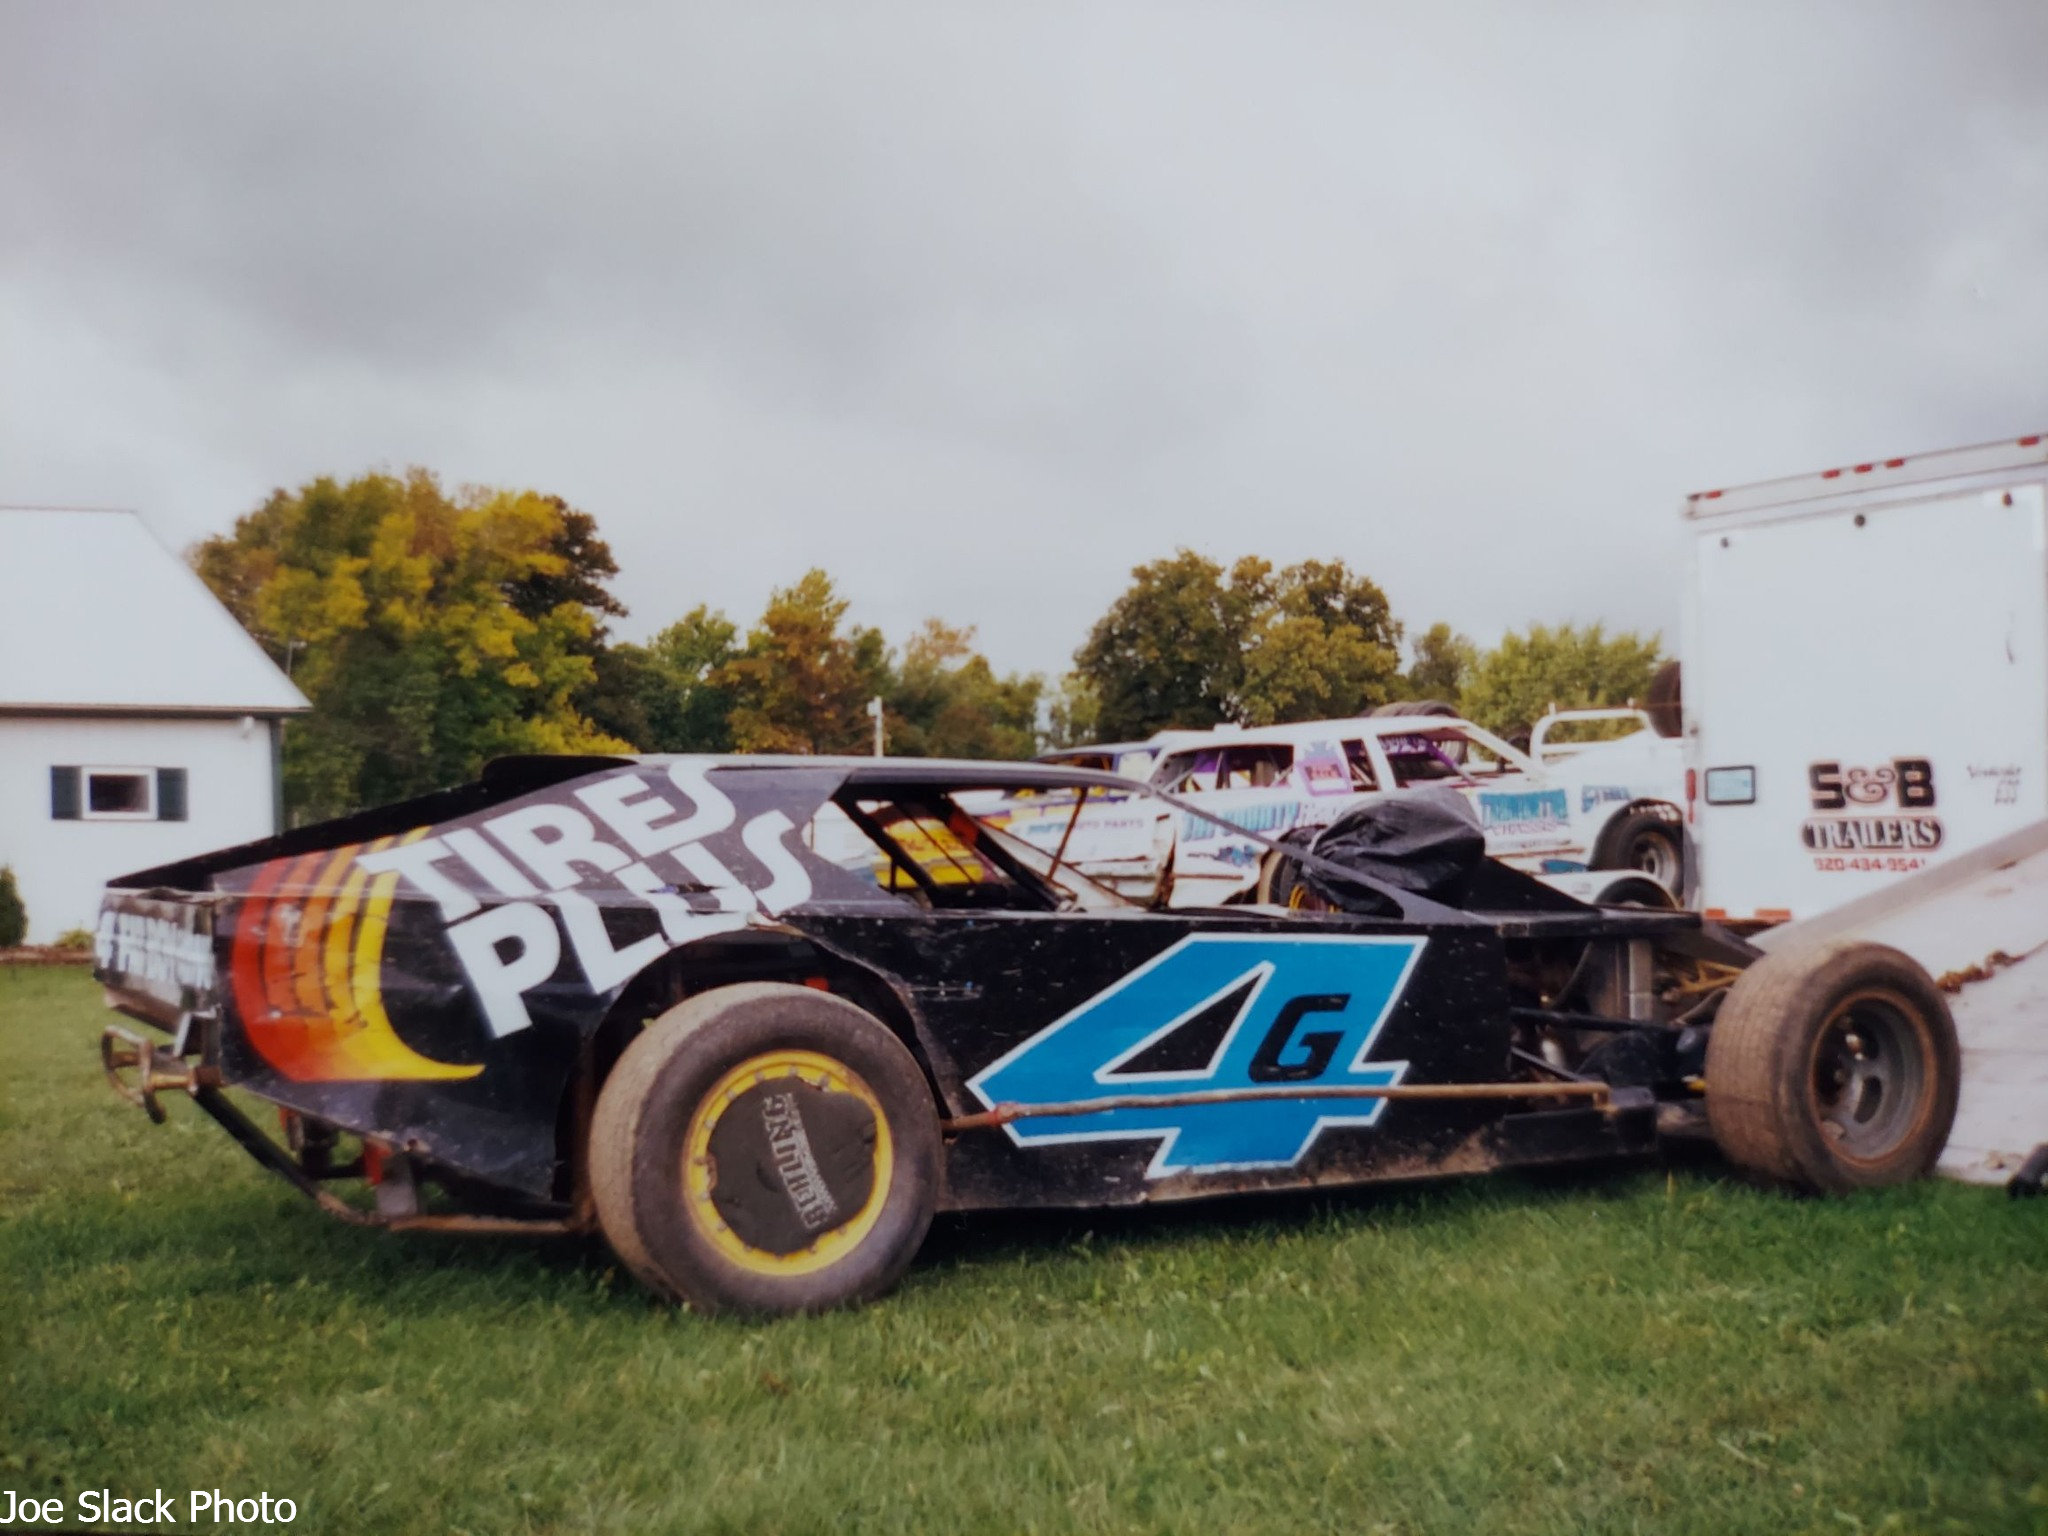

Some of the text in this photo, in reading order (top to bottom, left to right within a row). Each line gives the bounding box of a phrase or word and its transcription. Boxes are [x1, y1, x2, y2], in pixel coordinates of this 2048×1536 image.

[1809, 819, 1939, 849] TRAILERS
[1810, 759, 1935, 809] S&B
[355, 758, 736, 923] TIRES
[447, 810, 813, 1040] PLUS
